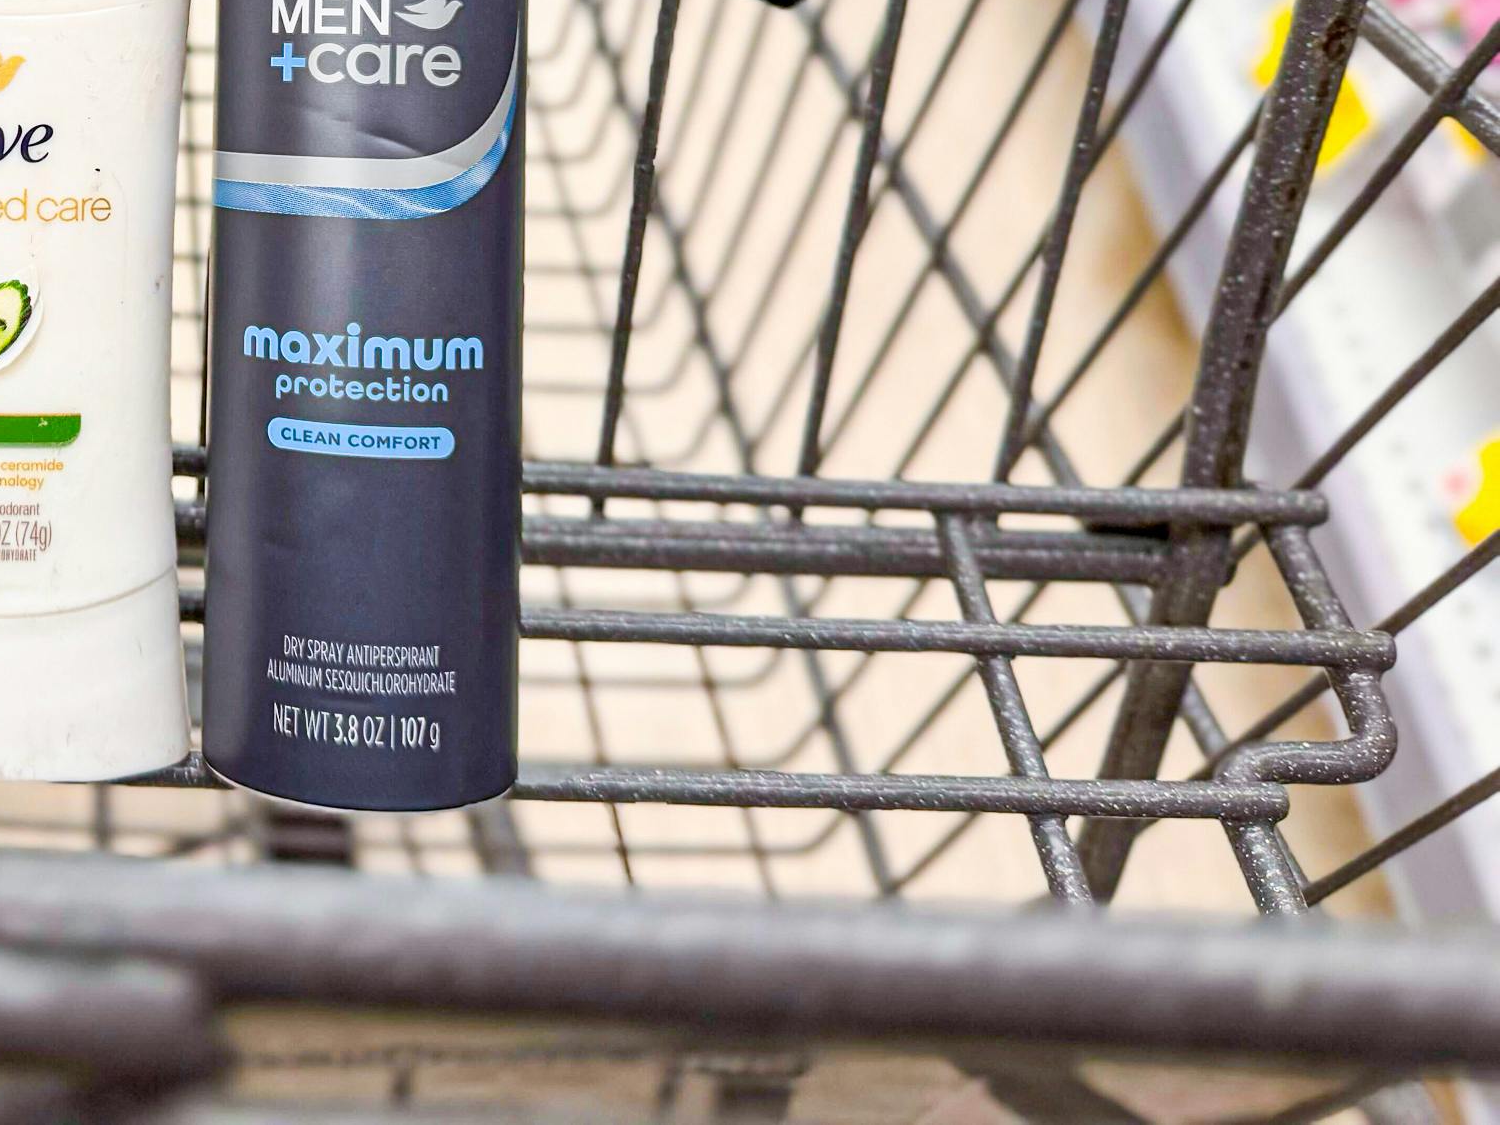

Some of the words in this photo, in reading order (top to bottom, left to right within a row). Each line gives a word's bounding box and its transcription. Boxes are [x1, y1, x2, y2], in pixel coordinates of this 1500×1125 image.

[36, 196, 112, 222] care
[244, 322, 484, 371] maximum
[275, 374, 449, 402] protection
[280, 427, 341, 446] CLEAN
[347, 434, 441, 450] COMFORT
[15, 520, 52, 551] (74g)
[284, 634, 304, 658] DRY
[307, 639, 344, 664] SPRAY
[347, 644, 440, 668] ANTIPERSPIRANT
[267, 658, 322, 688] ALUMINUM
[325, 668, 456, 695] SESQUICHLOROHYDRATE
[273, 702, 300, 738] NET
[304, 709, 330, 742] WT
[334, 713, 359, 745] 3.8
[363, 716, 385, 748] OZ
[400, 717, 426, 748] 107
[430, 722, 441, 752] g
